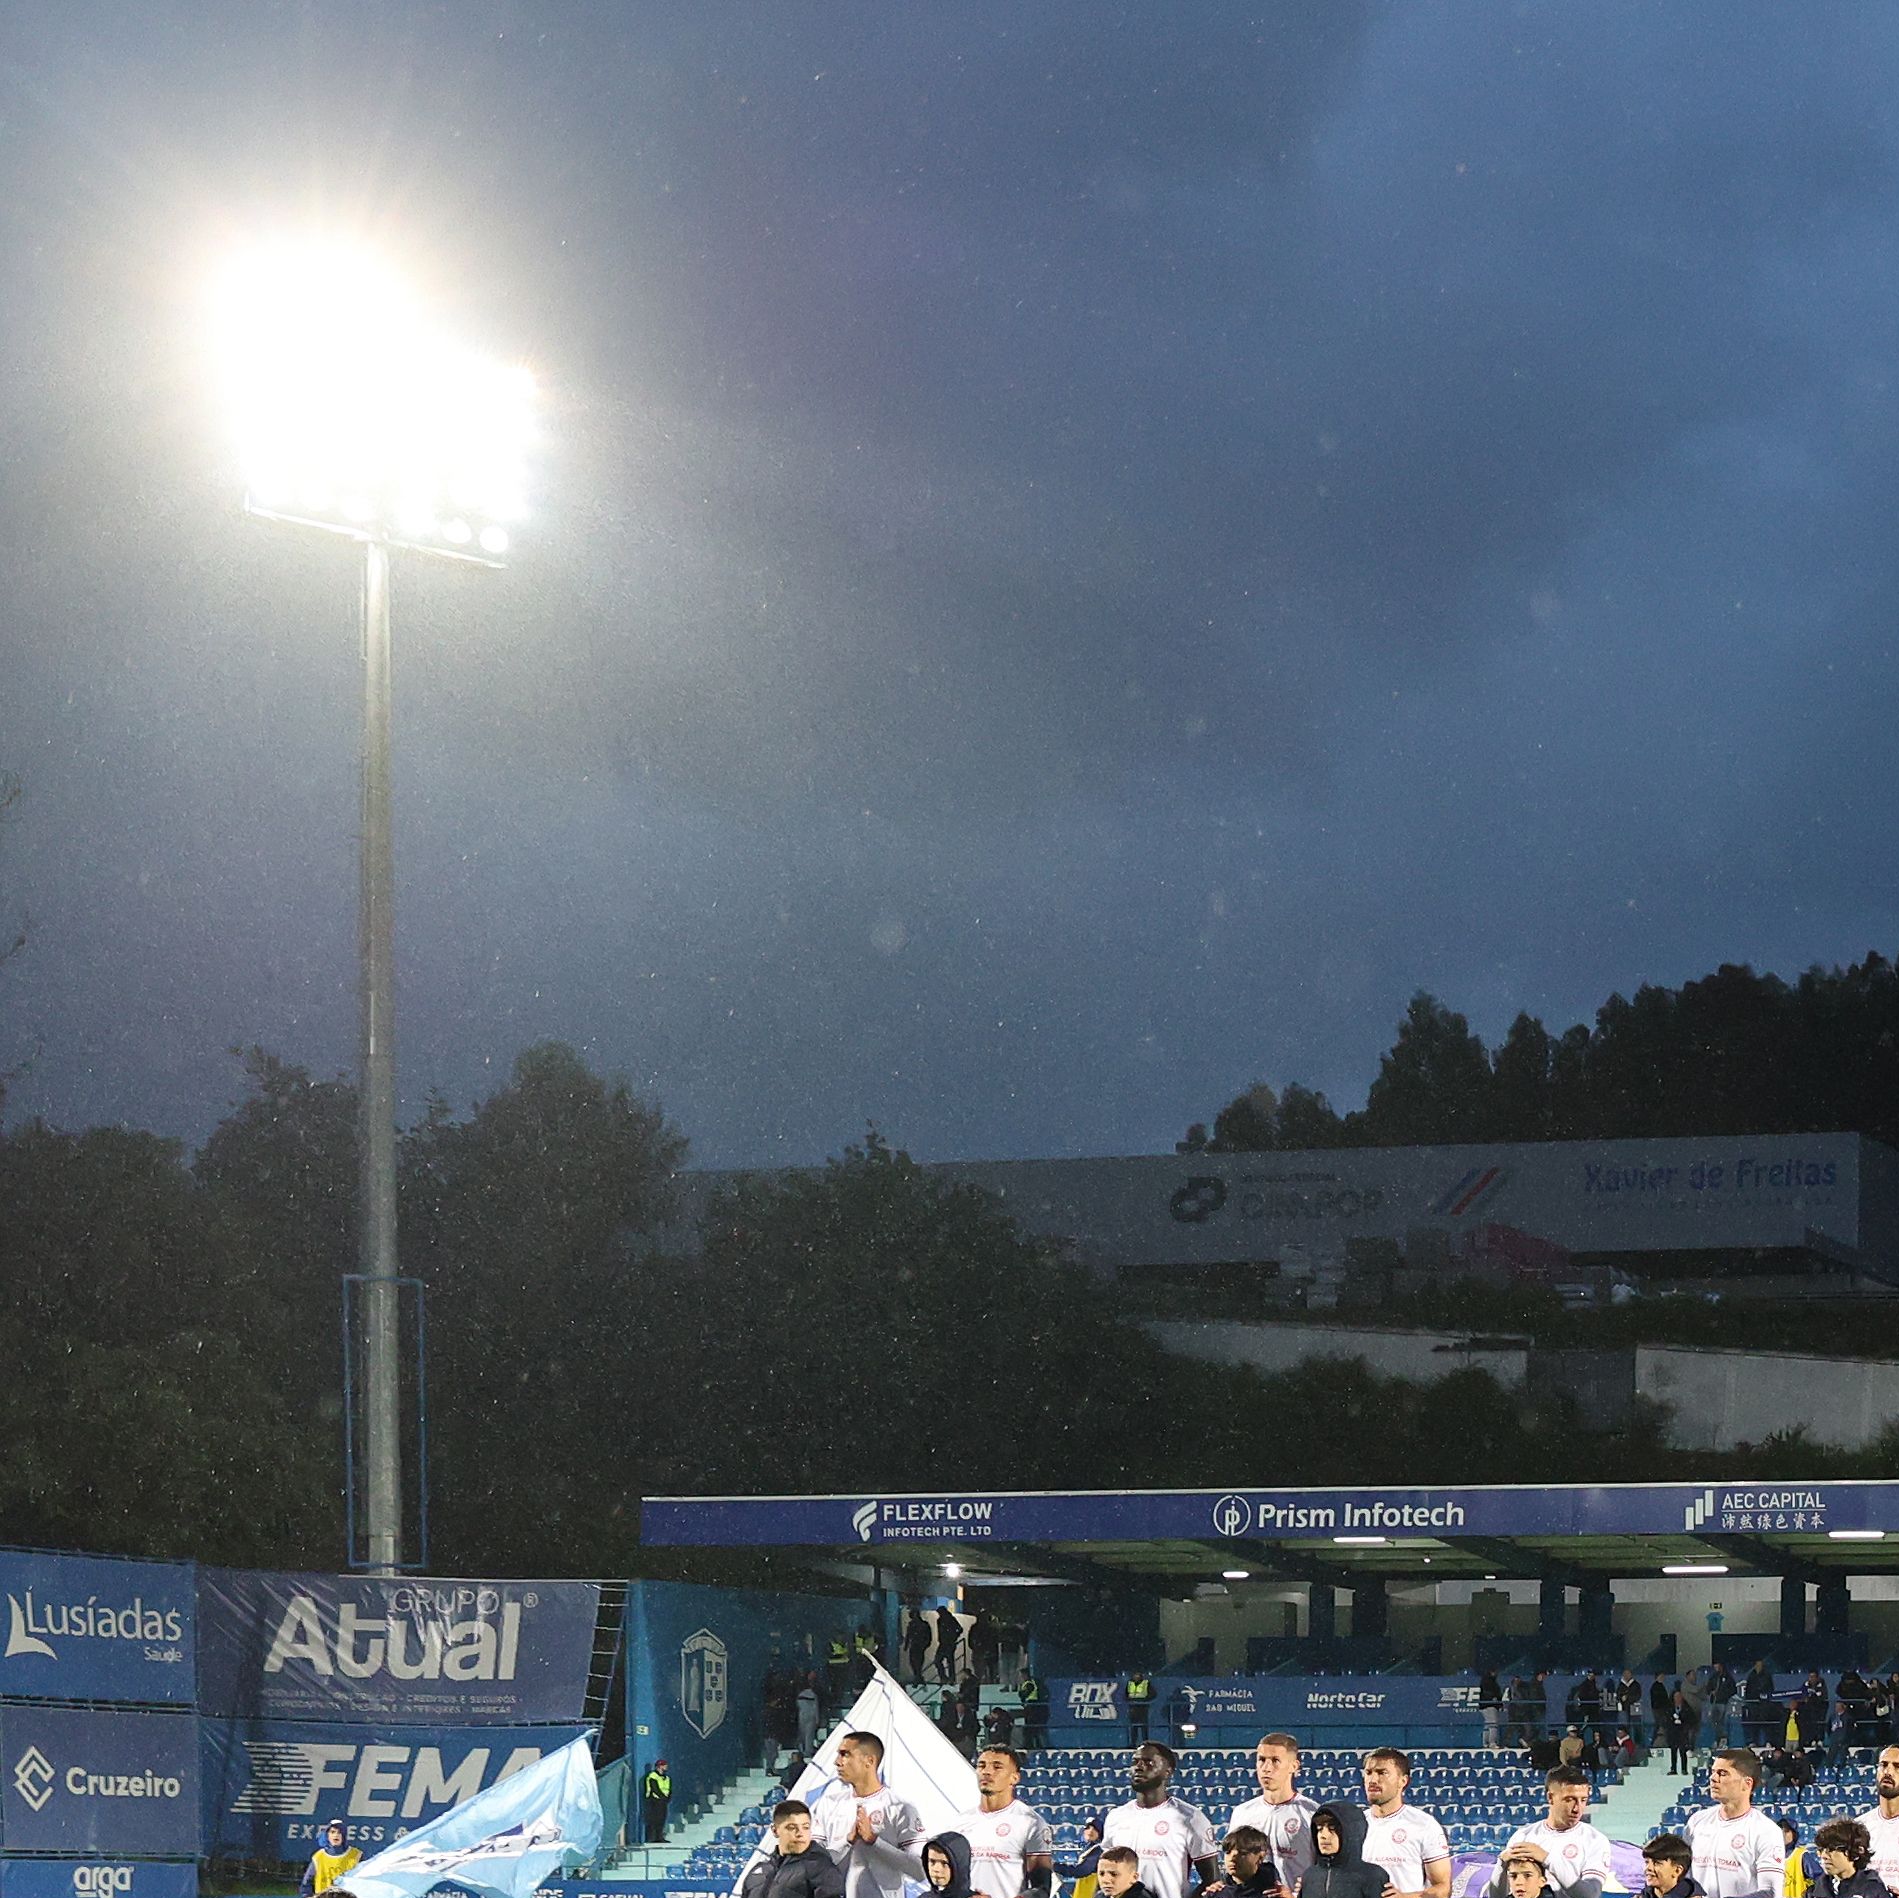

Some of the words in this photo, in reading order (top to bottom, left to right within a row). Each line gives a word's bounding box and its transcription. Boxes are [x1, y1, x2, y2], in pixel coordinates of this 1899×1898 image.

[883, 1502, 992, 1521] FLEXFLOW
[1722, 1493, 1755, 1509] AEC
[1758, 1492, 1826, 1508] CAPITAL
[1258, 1503, 1335, 1528] Prism
[1343, 1502, 1464, 1527] Infotech
[883, 1526, 940, 1537] INFOTECH
[943, 1526, 967, 1537] PTE.
[970, 1526, 992, 1536] LTD
[390, 1586, 500, 1616] GRUPO
[25, 1591, 183, 1642] Lusíadas
[264, 1595, 522, 1682] Atual
[66, 1767, 181, 1798] Cruzeiro
